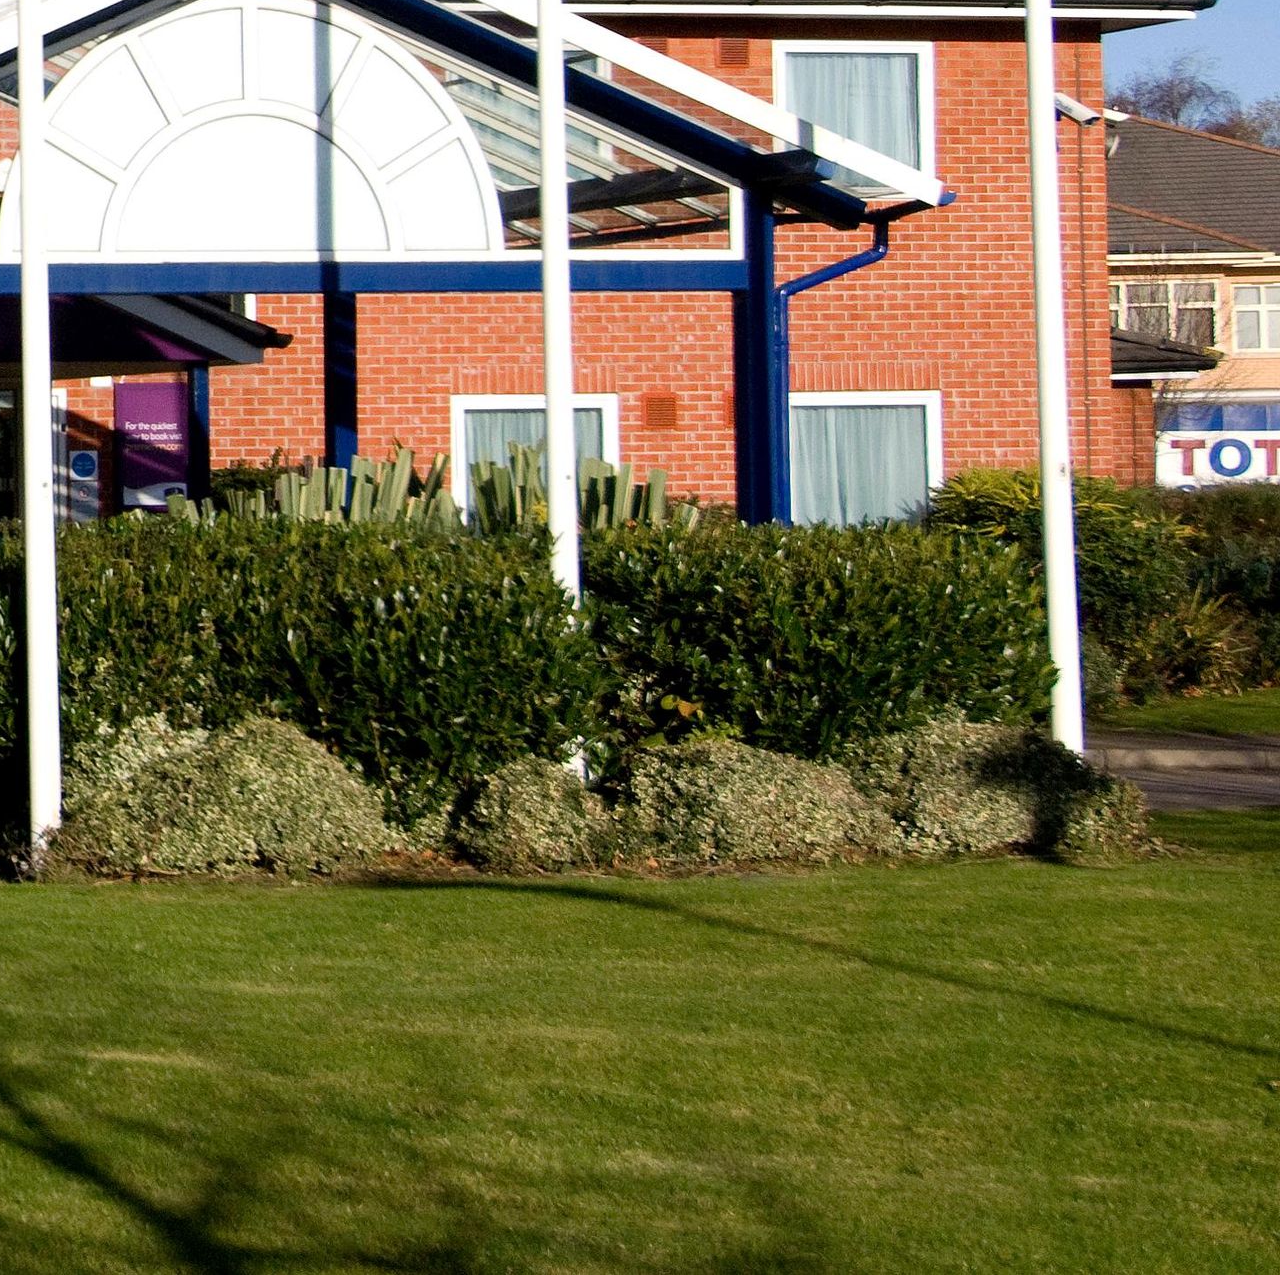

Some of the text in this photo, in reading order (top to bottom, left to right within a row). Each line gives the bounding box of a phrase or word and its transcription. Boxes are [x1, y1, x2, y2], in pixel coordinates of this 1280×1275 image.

[126, 422, 137, 430] For
[138, 422, 150, 430] the
[1170, 438, 1280, 477] TOT
